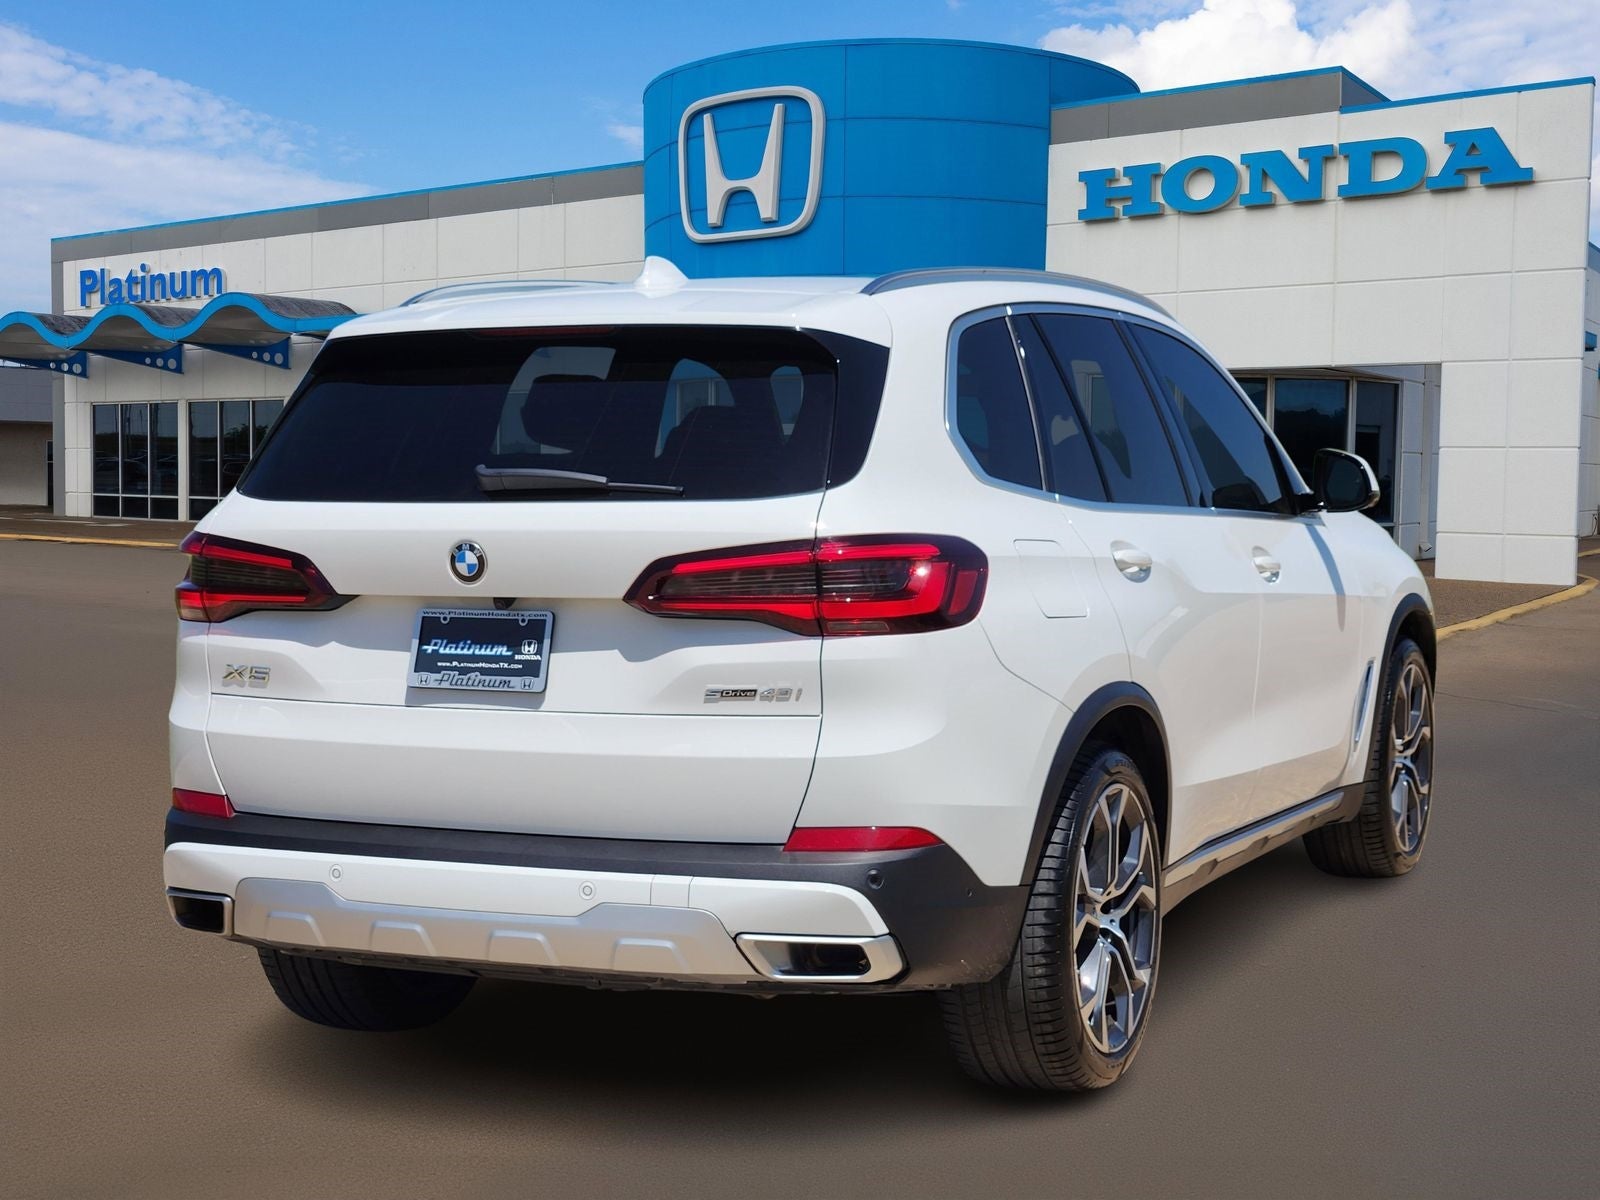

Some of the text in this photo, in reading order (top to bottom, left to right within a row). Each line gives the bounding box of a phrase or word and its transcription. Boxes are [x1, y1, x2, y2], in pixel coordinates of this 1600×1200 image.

[1078, 127, 1534, 221] HONDA
[80, 263, 226, 307] Platinum
[421, 639, 514, 656] Platinum
[222, 664, 271, 686] X5
[433, 671, 516, 690] Platinum
